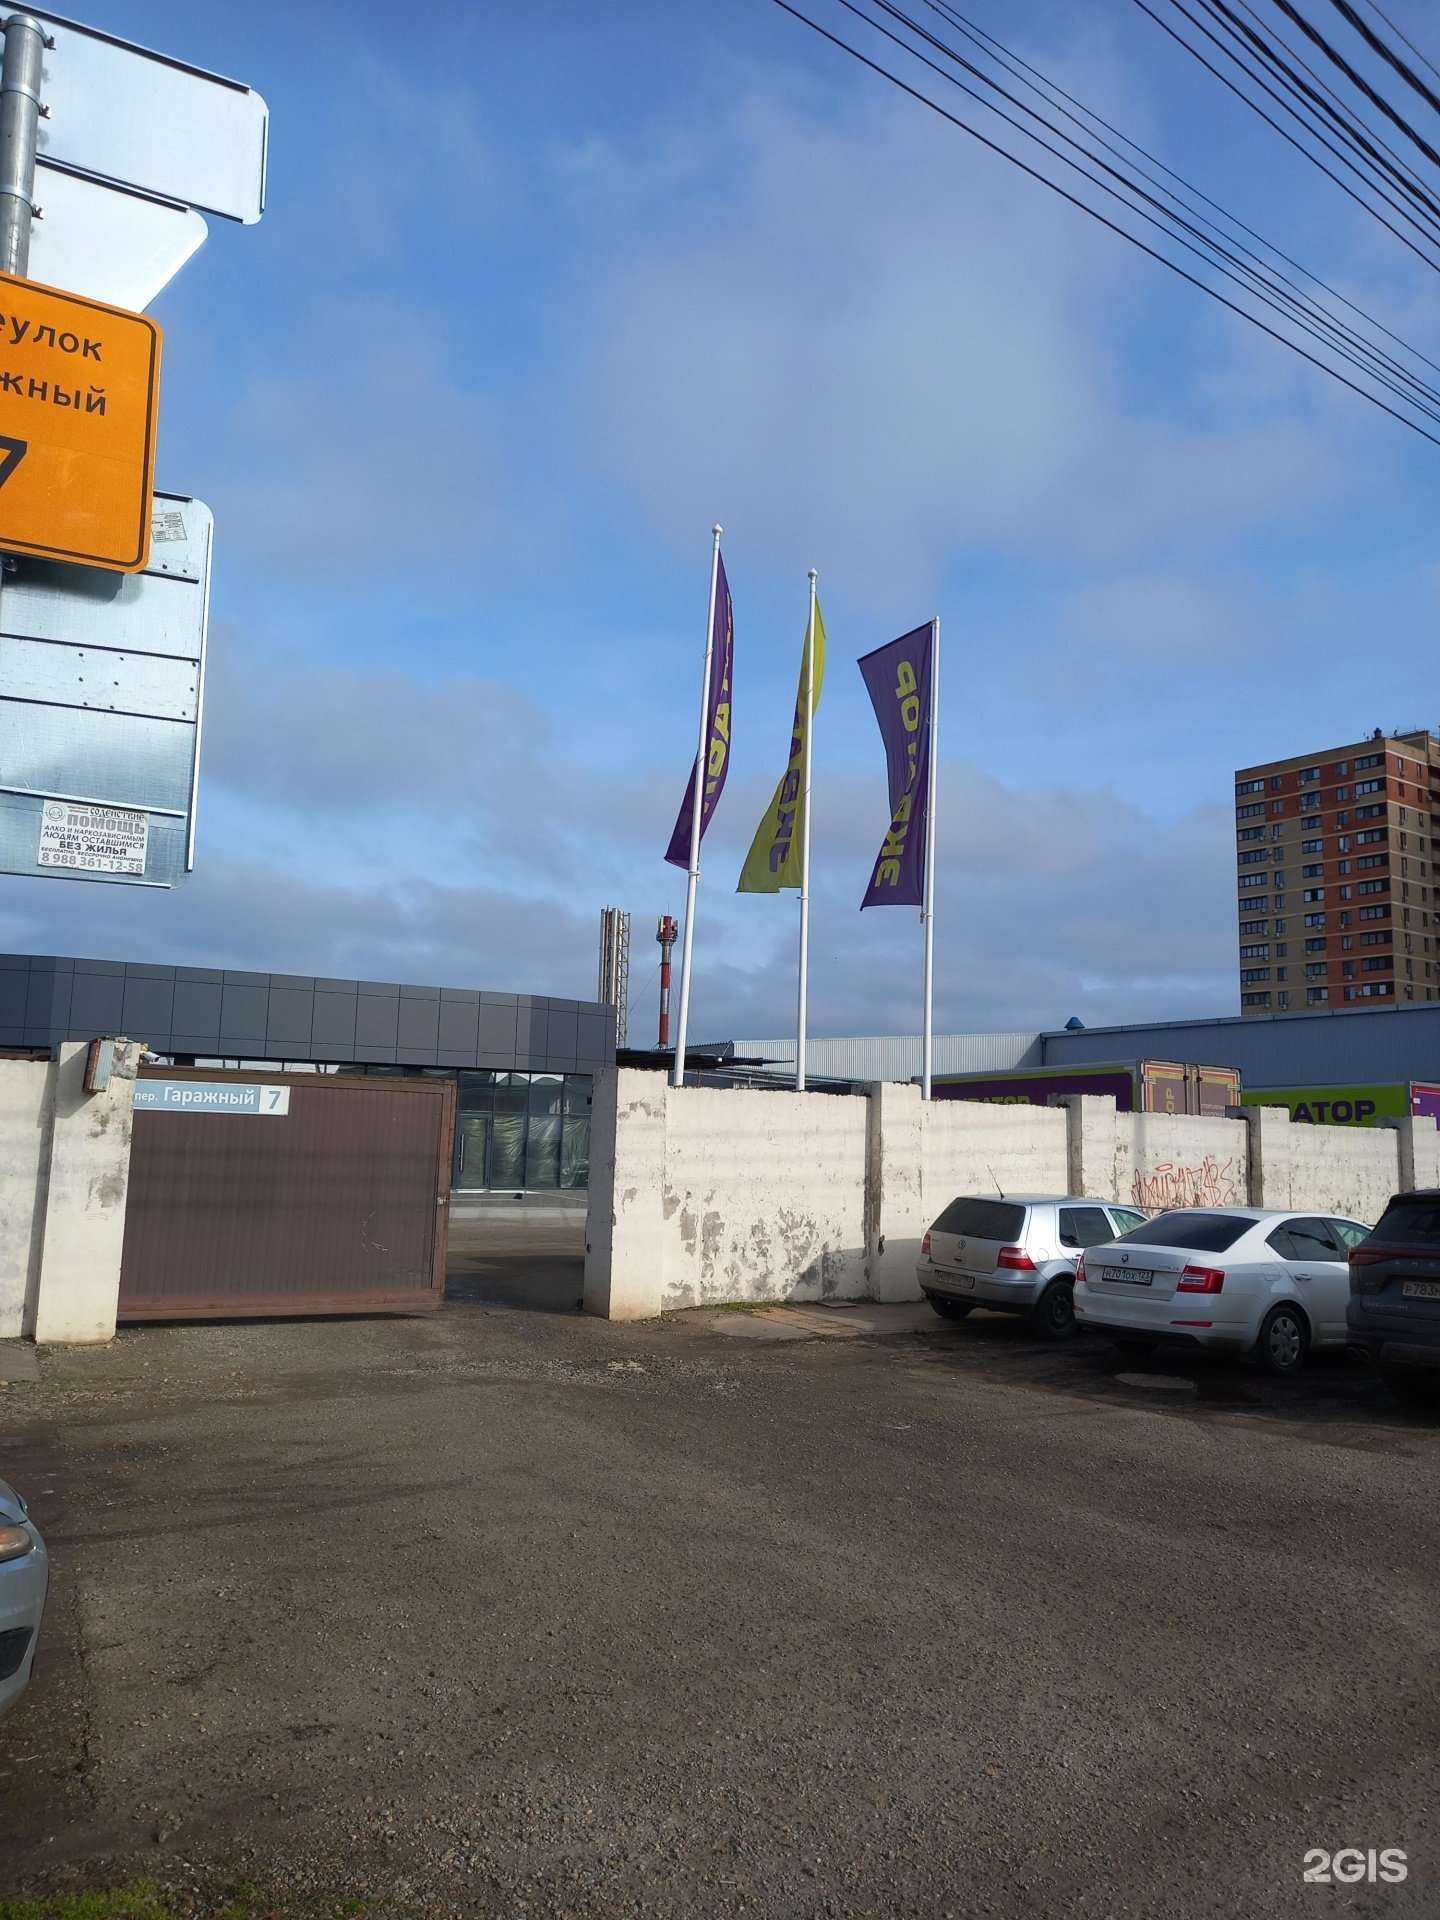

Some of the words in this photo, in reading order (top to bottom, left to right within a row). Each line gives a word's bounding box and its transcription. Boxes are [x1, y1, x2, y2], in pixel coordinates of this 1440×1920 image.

[44, 824, 66, 832] АЛКО
[74, 829, 145, 842] НАРКОЗАВИСИМЫМ
[67, 814, 145, 835] ПОМОЩЬ
[43, 831, 79, 841] ЛЮДЯМ
[81, 835, 145, 849] ОСТАВШИМСЯ
[59, 840, 82, 851] БЕЗ
[85, 843, 127, 856] ЖИЛЬЯ
[42, 852, 50, 862] 8
[53, 853, 77, 865] 988
[79, 856, 143, 873] 361-12-58
[134, 1092, 158, 1103] пер.
[163, 1086, 255, 1106] Гаражный
[268, 1090, 281, 1110] 7
[1279, 1100, 1376, 1123] АТОР
